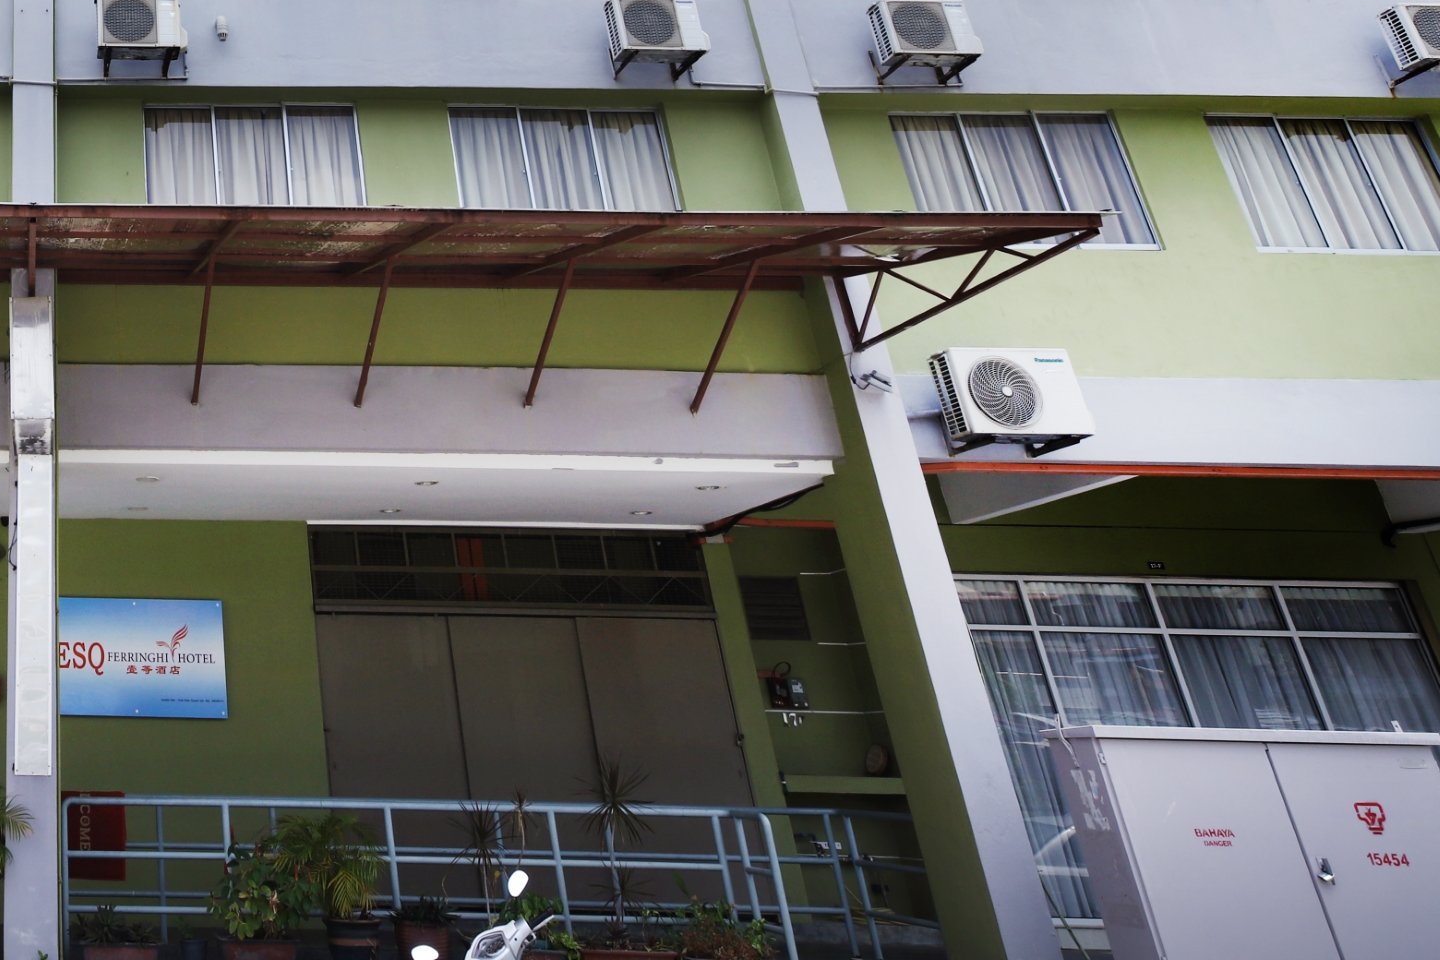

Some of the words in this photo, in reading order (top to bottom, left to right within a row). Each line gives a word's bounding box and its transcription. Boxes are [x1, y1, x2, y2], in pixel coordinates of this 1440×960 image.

[59, 642, 105, 676] ESQ
[107, 651, 169, 663] FERRINGHI
[177, 653, 216, 664] HOTEL
[1194, 828, 1235, 838] BAHAYA
[1366, 852, 1410, 866] 15454
